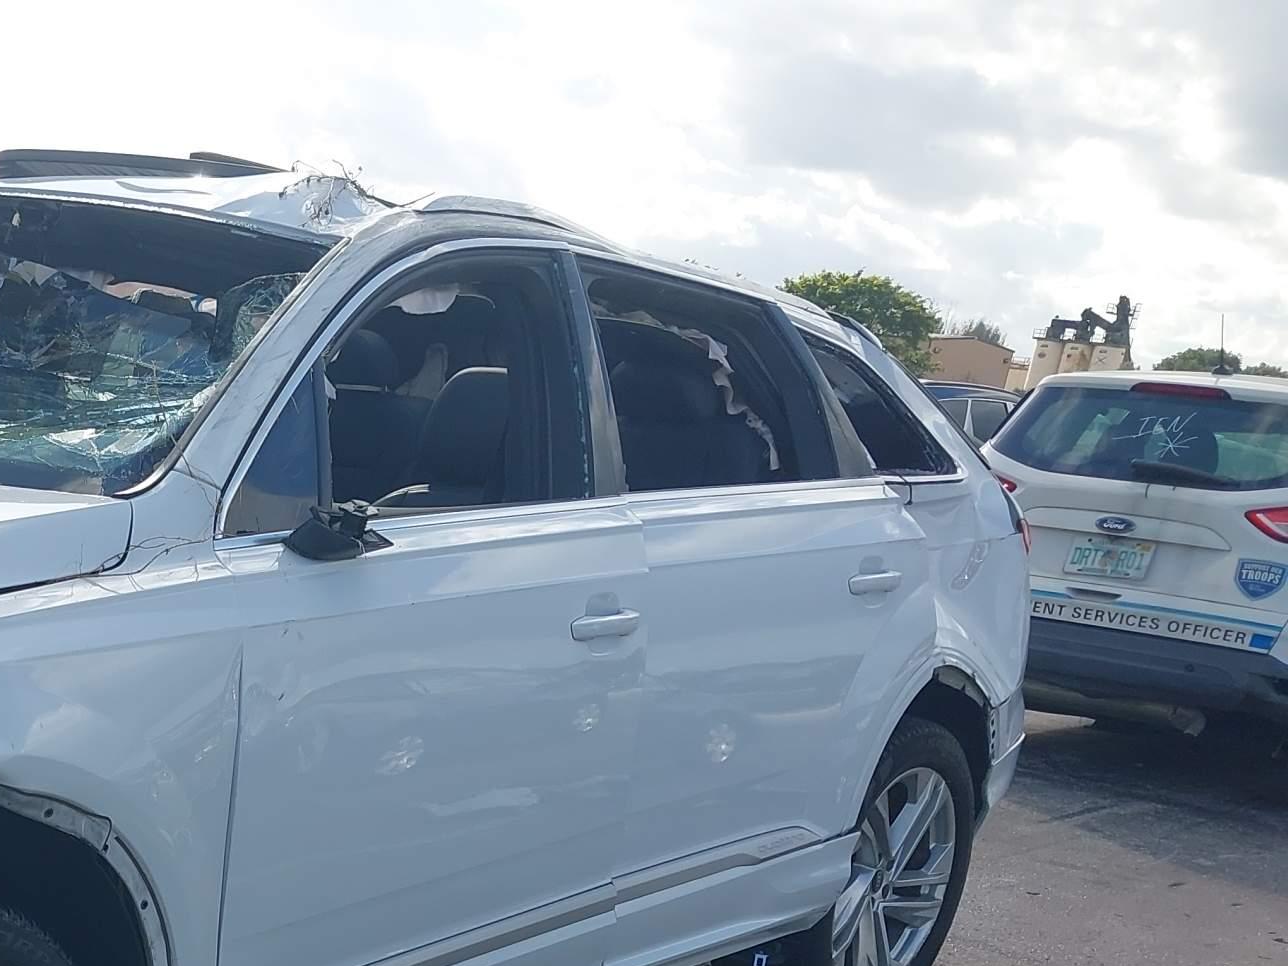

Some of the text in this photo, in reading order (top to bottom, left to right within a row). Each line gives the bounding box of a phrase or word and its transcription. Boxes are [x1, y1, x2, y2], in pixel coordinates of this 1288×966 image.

[1103, 519, 1127, 530] Ford
[1241, 569, 1282, 585] TROOPS
[1032, 601, 1247, 645] ENT SERVICES OFFICER
